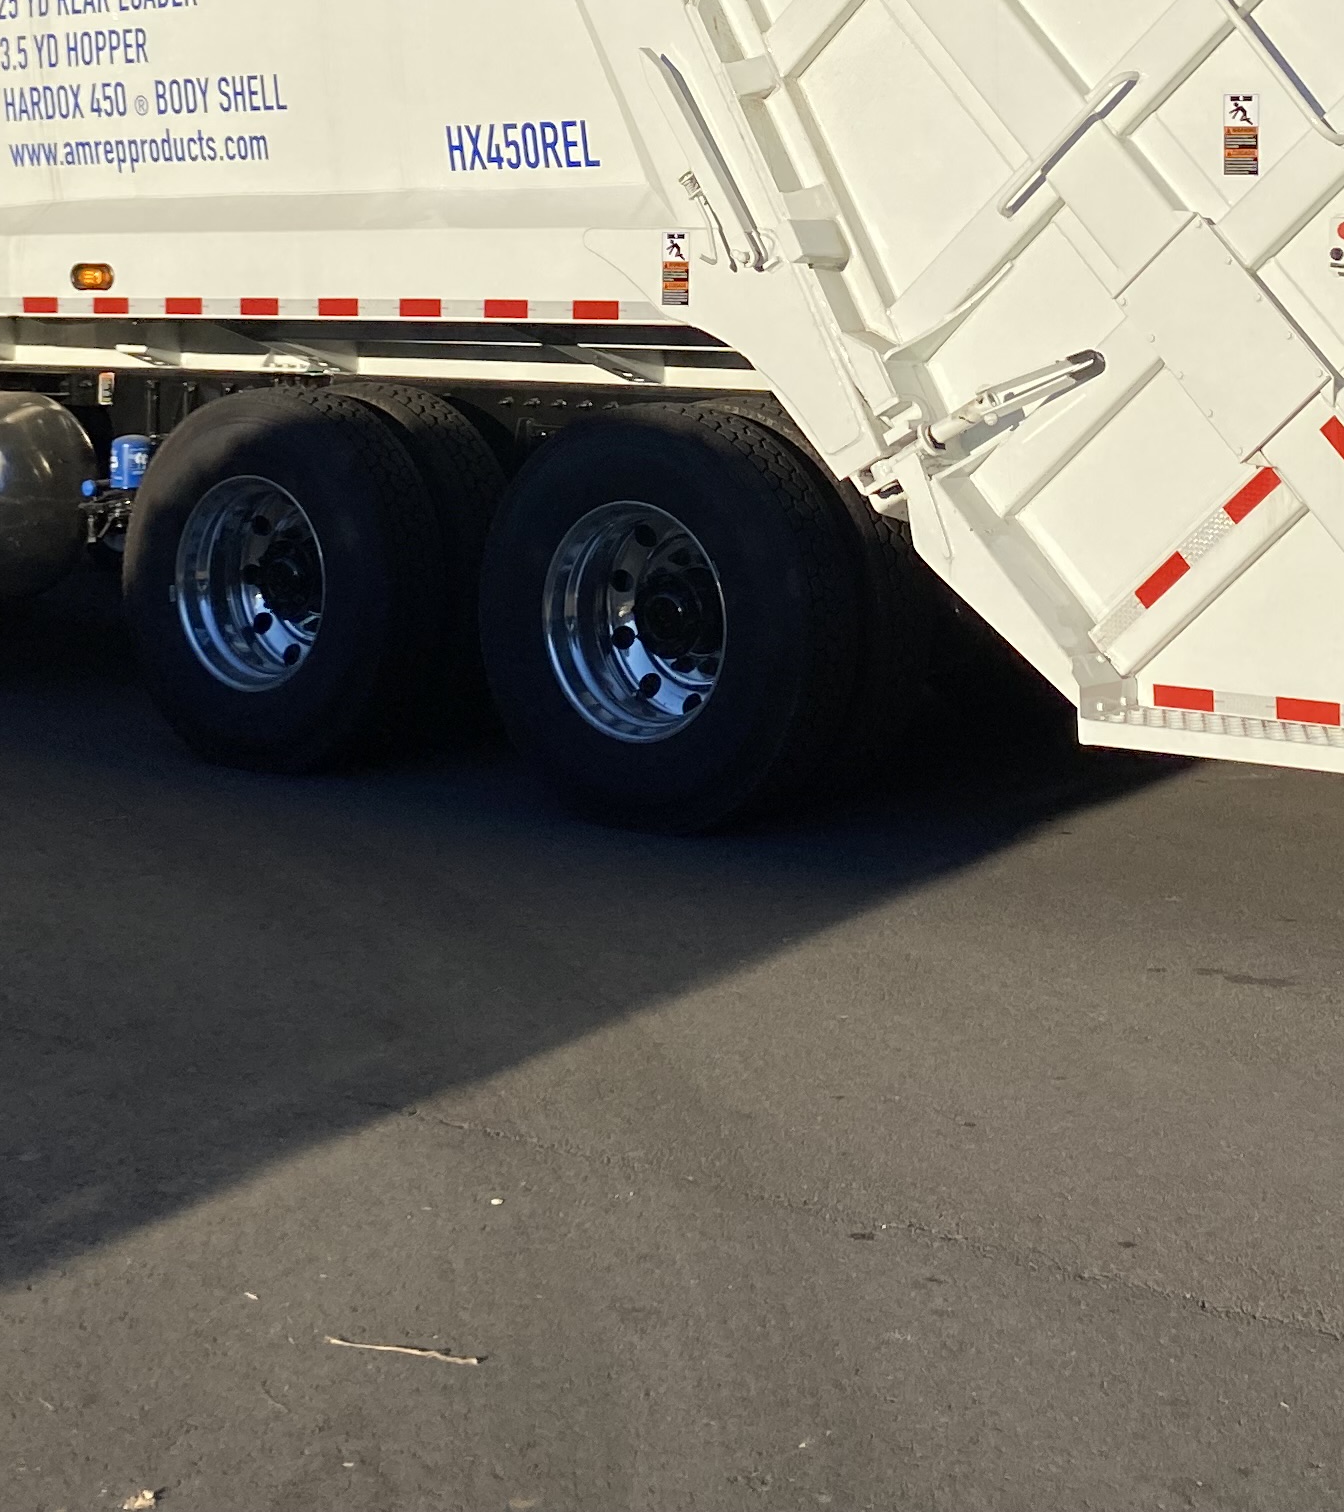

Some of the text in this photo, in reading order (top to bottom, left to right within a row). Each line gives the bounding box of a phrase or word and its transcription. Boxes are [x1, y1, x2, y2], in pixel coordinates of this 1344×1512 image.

[0, 28, 149, 71] 3.5 YD HOPPER
[3, 84, 85, 122] HARDOX
[90, 81, 127, 118] 450
[154, 77, 208, 116] BODY
[217, 73, 288, 113] SHELL
[8, 128, 270, 174] www.amrepproducts.com
[445, 119, 601, 171] HX450REL
